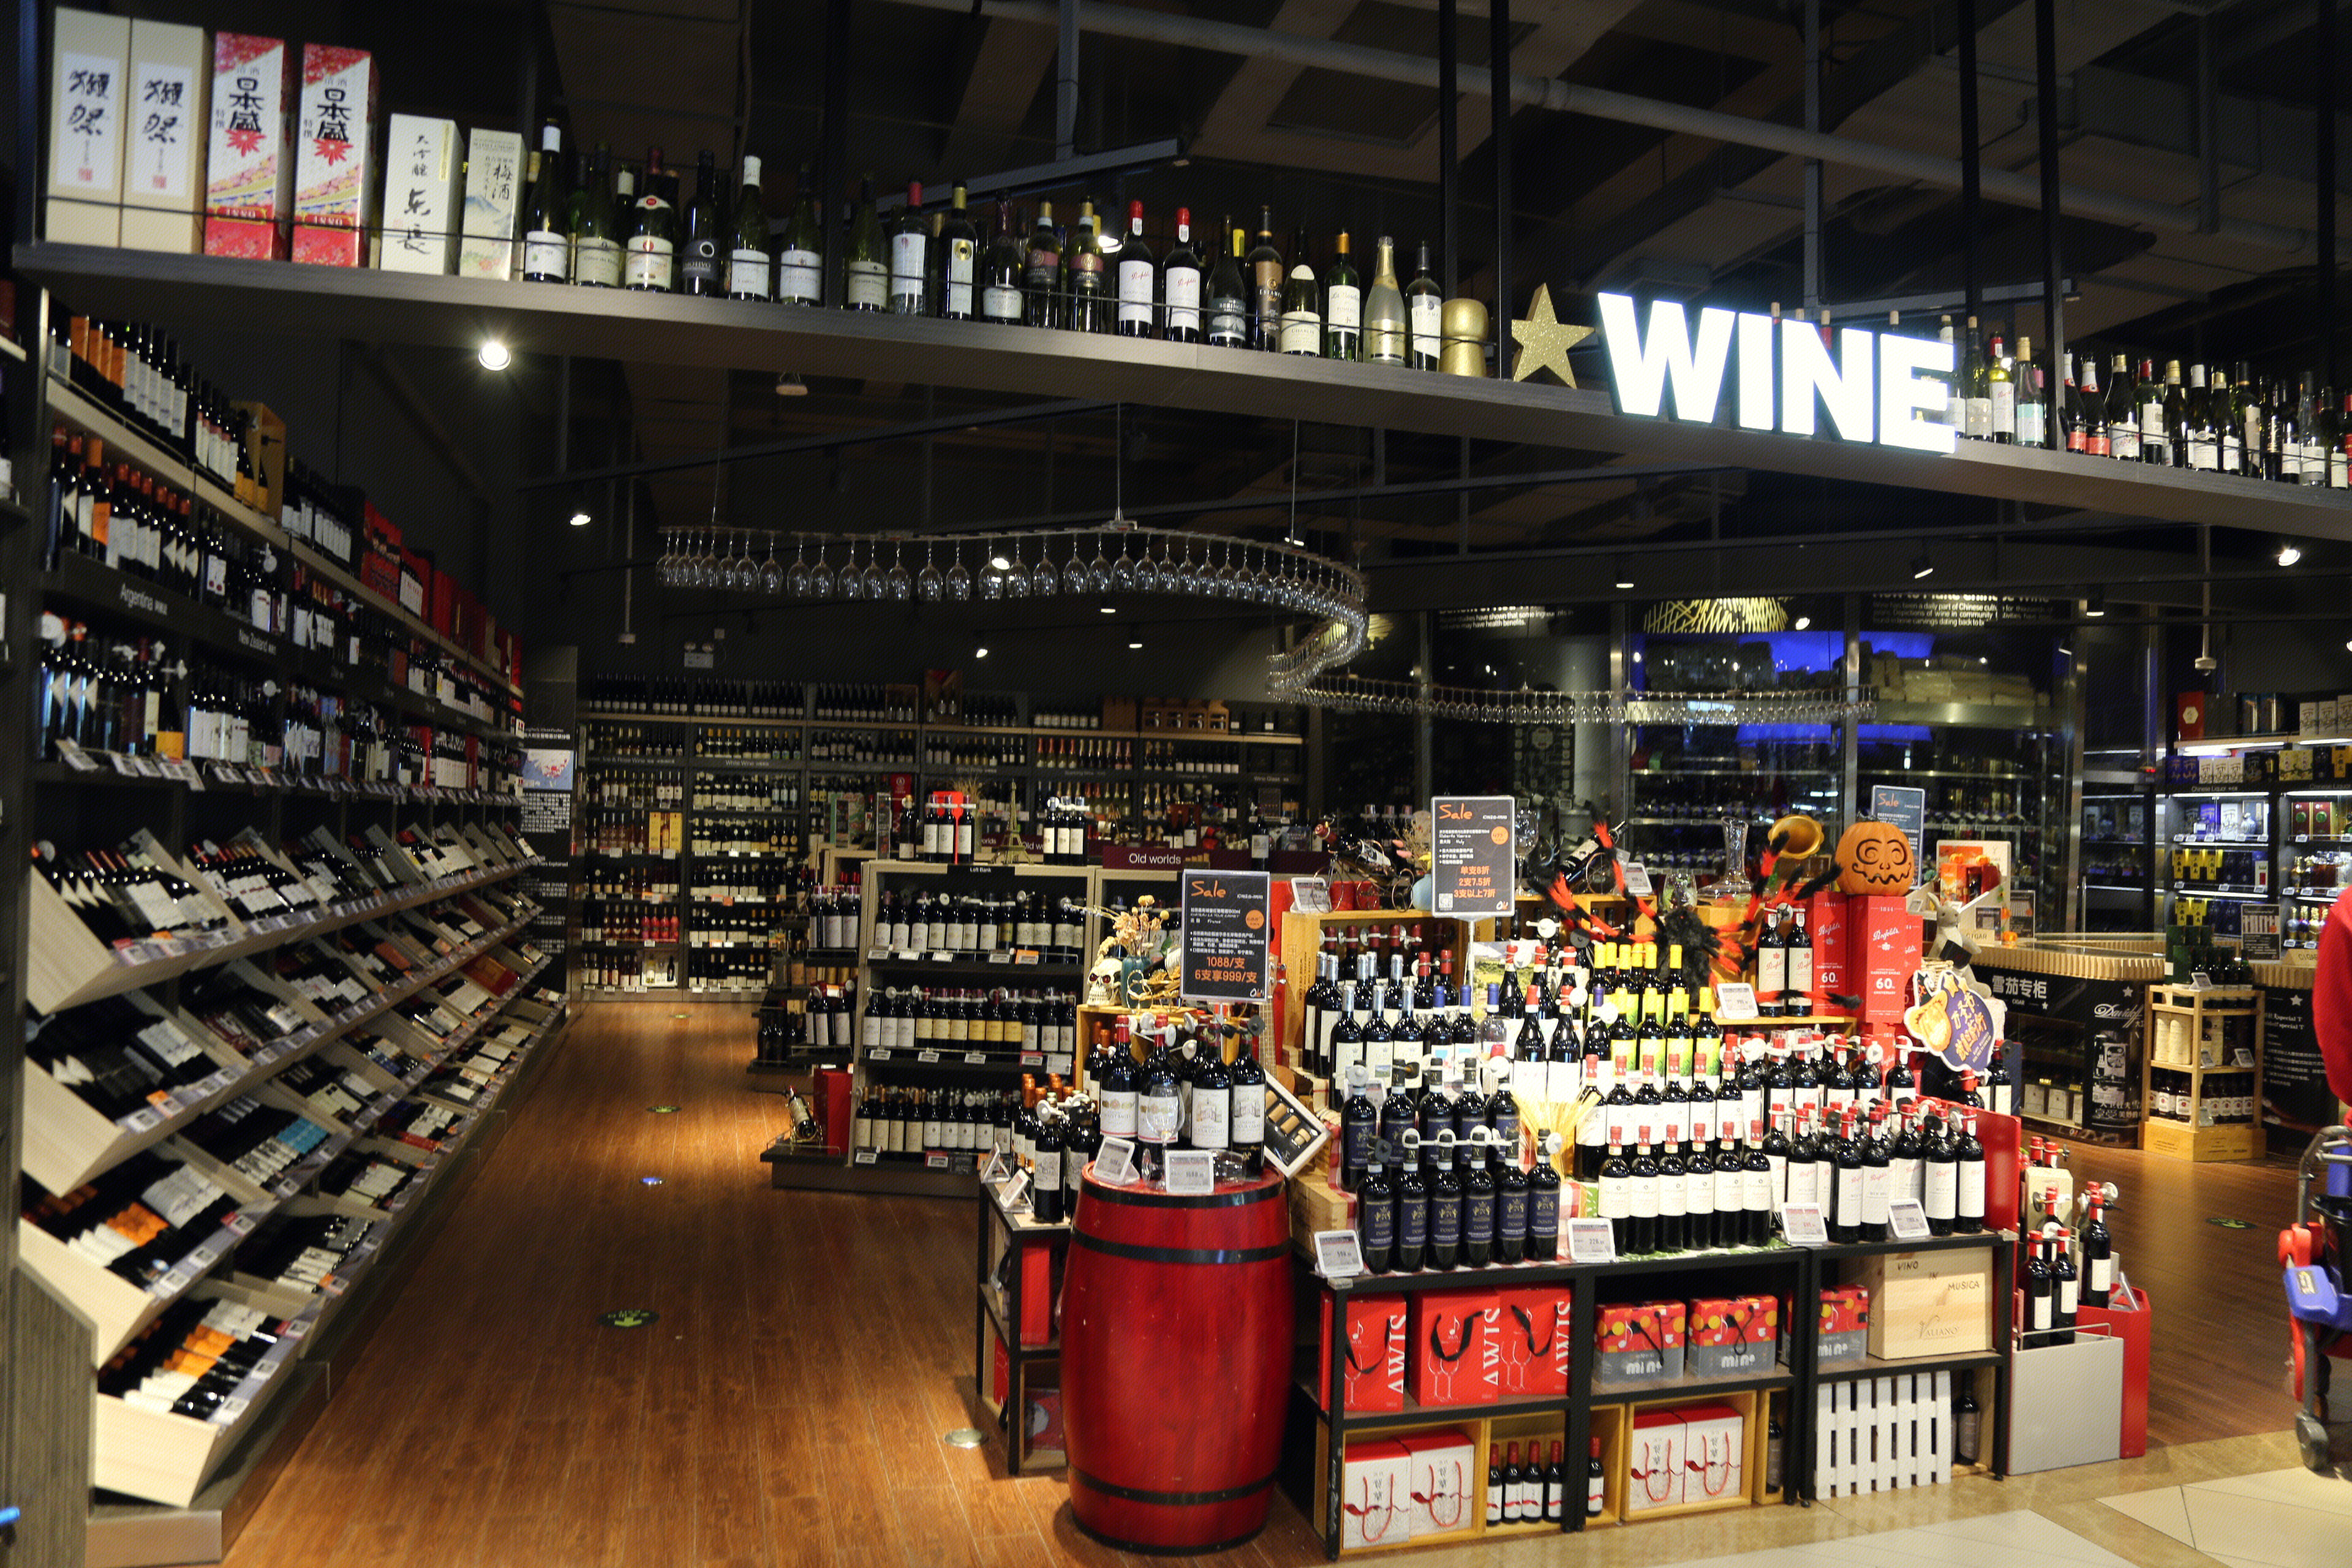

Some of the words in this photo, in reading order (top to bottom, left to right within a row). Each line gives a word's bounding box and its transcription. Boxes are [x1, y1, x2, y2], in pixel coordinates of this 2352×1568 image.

[492, 164, 513, 200] 梅酒
[1597, 292, 1955, 454] WINE
[119, 582, 153, 611] Argentina
[1959, 603, 1983, 611] Chinese
[1939, 618, 1958, 627] dating
[1877, 793, 1899, 807] Sale
[1439, 802, 1473, 820] Sale
[1129, 853, 1152, 864] Old
[1155, 854, 1182, 864] worlds
[1461, 865, 1490, 875] 单支8折
[1458, 876, 1491, 887] 2支7.5折
[1191, 880, 1226, 898] Sale
[1454, 888, 1496, 899] 3支以上7折
[1818, 922, 1841, 936] Penfolds
[1872, 927, 1899, 941] Penfolds
[1207, 957, 1245, 969] 1088/支
[1195, 969, 1257, 984] 6支享999/支
[1992, 975, 2047, 999] 雪茄专柜
[2094, 1003, 2144, 1028] Davidoff
[1898, 1261, 1919, 1270] VINO
[1929, 1272, 1939, 1280] IN
[1948, 1281, 1980, 1291] MUSICA
[1556, 1300, 1570, 1375] AWIS
[1483, 1307, 1500, 1385] AWIS
[1387, 1314, 1406, 1393] AWIS
